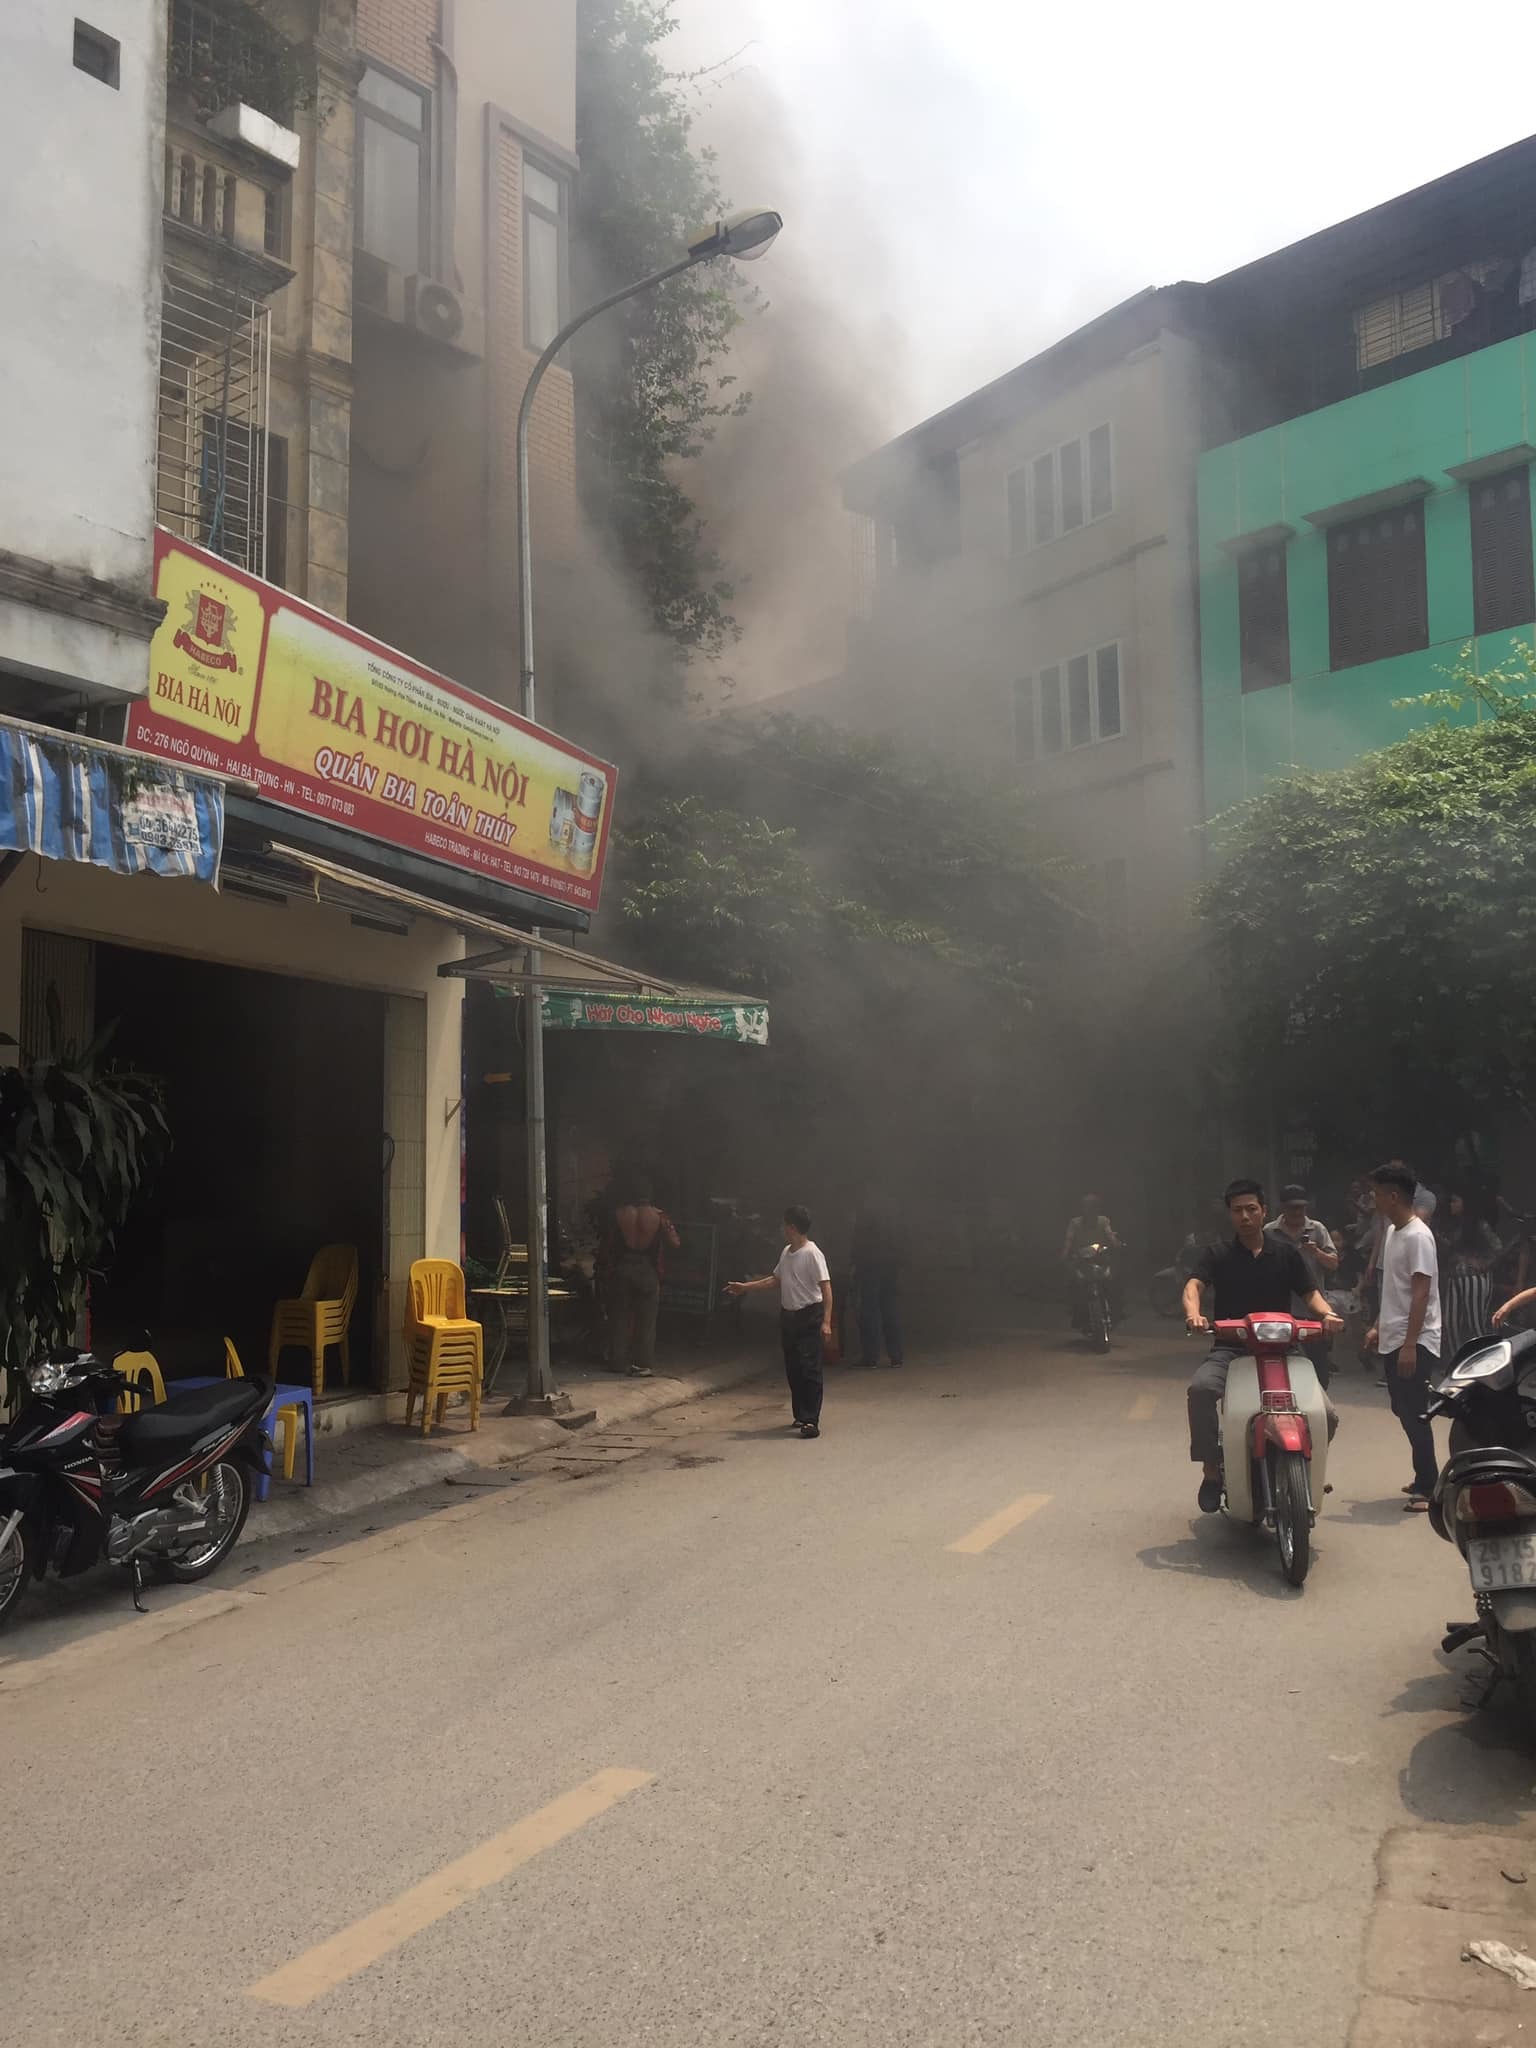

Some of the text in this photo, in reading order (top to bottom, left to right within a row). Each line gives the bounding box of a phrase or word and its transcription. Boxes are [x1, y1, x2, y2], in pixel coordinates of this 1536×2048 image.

[190, 645, 222, 665] HABECO
[155, 672, 184, 705] BIA
[187, 685, 210, 715] HÀ
[213, 696, 242, 728] NỘI
[310, 676, 367, 738] BIA
[373, 706, 434, 765] HƠI
[437, 736, 476, 786] HÀ
[482, 757, 530, 809] NỘI
[136, 726, 153, 744] ĐC:
[153, 732, 170, 749] 276
[170, 738, 190, 756] NGÕ
[190, 745, 220, 767] QUỲNH
[226, 758, 241, 775] HAI
[241, 763, 253, 778] BÀ
[254, 768, 280, 789] TRƯNG
[284, 780, 295, 794] HN
[301, 786, 316, 802] TEL:
[315, 746, 517, 847] QUÁN BIA TOẢN THÚY
[424, 832, 448, 849] HABECO
[448, 839, 470, 858] TRADING
[585, 1004, 613, 1023] Hát
[615, 1005, 645, 1024] Cho
[647, 1006, 684, 1027] Nhau
[686, 1010, 723, 1034] Nghe
[64, 1456, 94, 1470] HONDA
[1480, 1562, 1536, 1586] 9182
